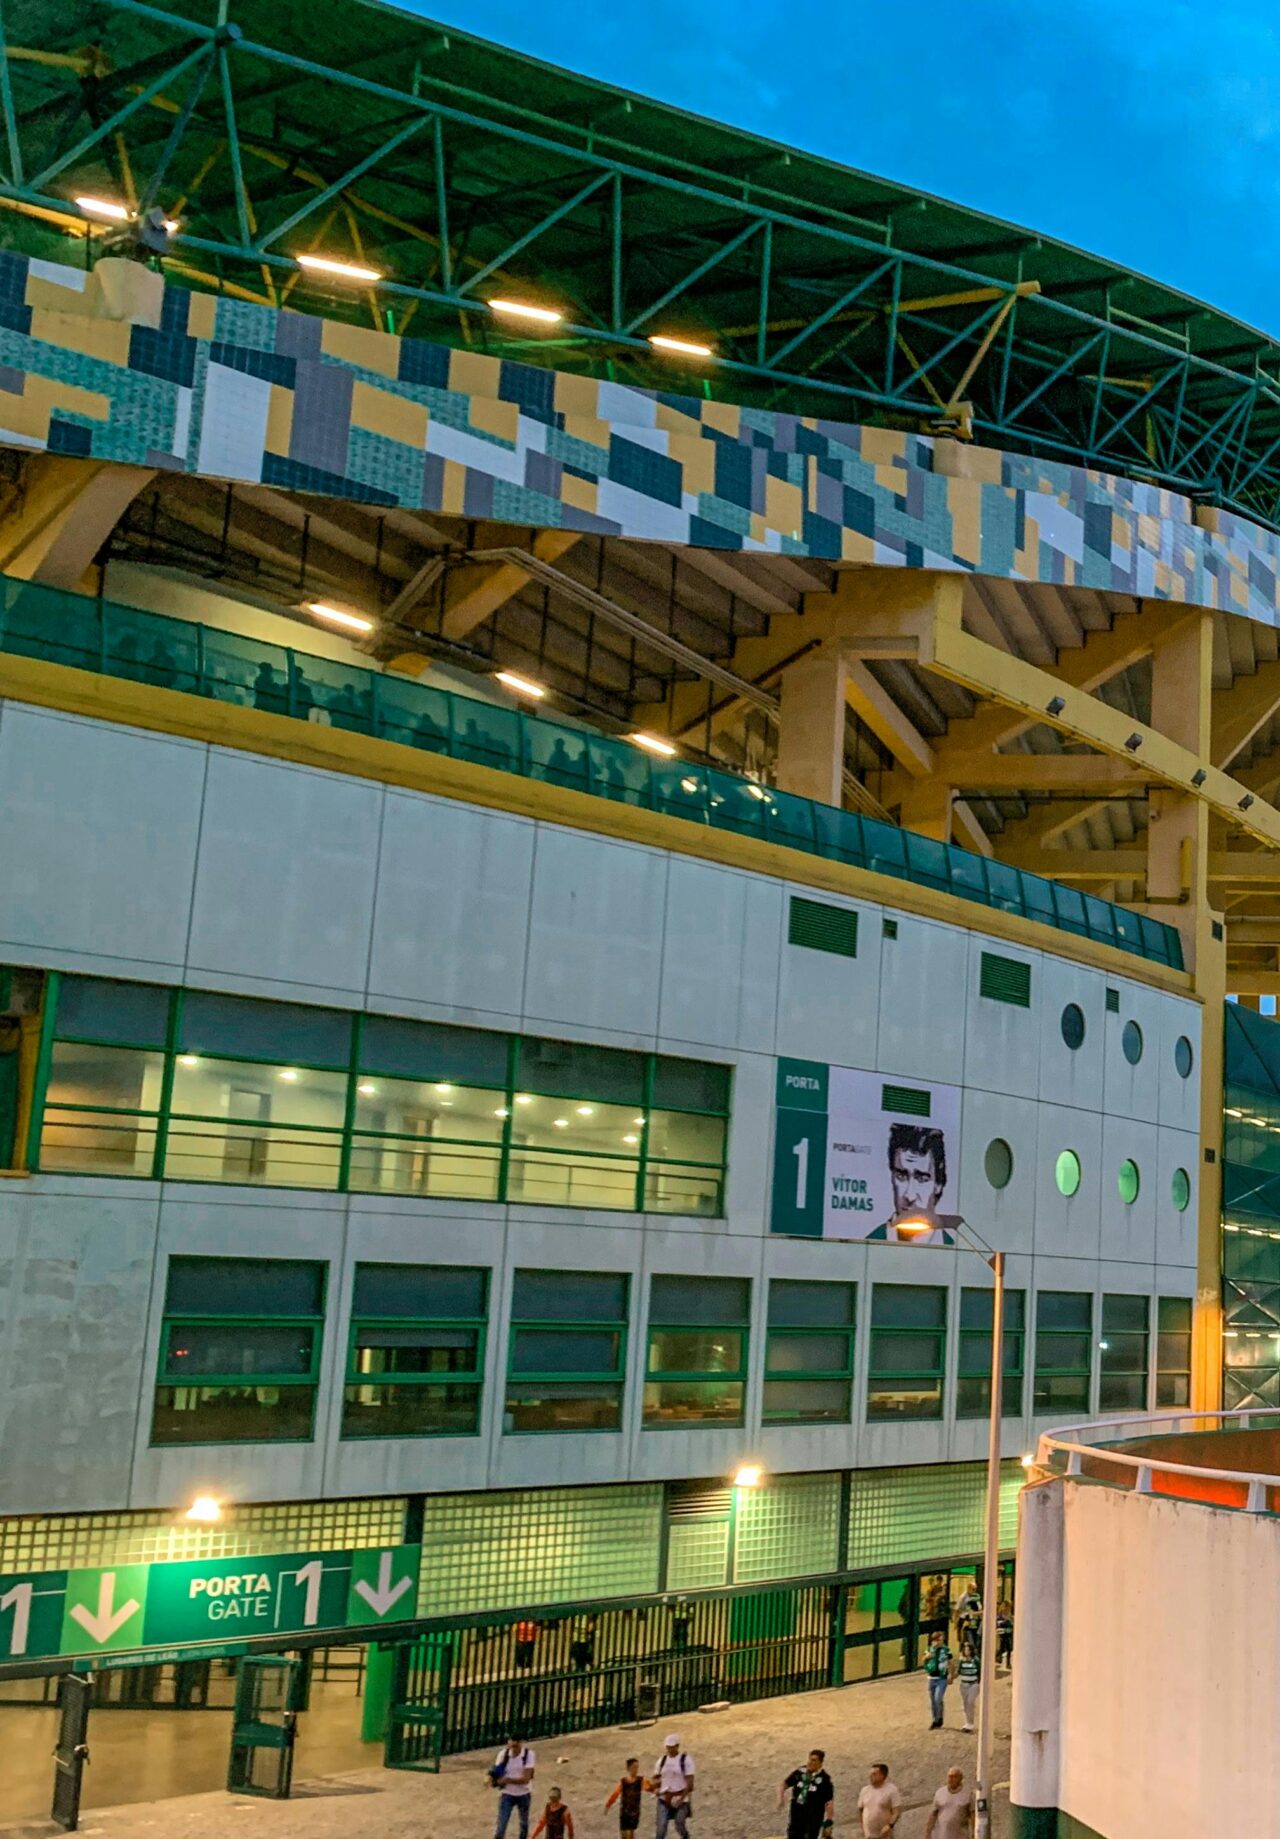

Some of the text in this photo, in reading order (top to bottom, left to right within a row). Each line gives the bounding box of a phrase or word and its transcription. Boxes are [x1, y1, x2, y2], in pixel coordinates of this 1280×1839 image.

[785, 1075, 820, 1091] PORTA
[792, 1137, 809, 1209] 1
[832, 1173, 868, 1194] VÍTOR
[831, 1195, 874, 1212] DAMAS
[189, 1573, 272, 1599] PORTA
[294, 1560, 323, 1626] 1
[0, 1582, 34, 1655] 1
[207, 1596, 270, 1620] GATE
